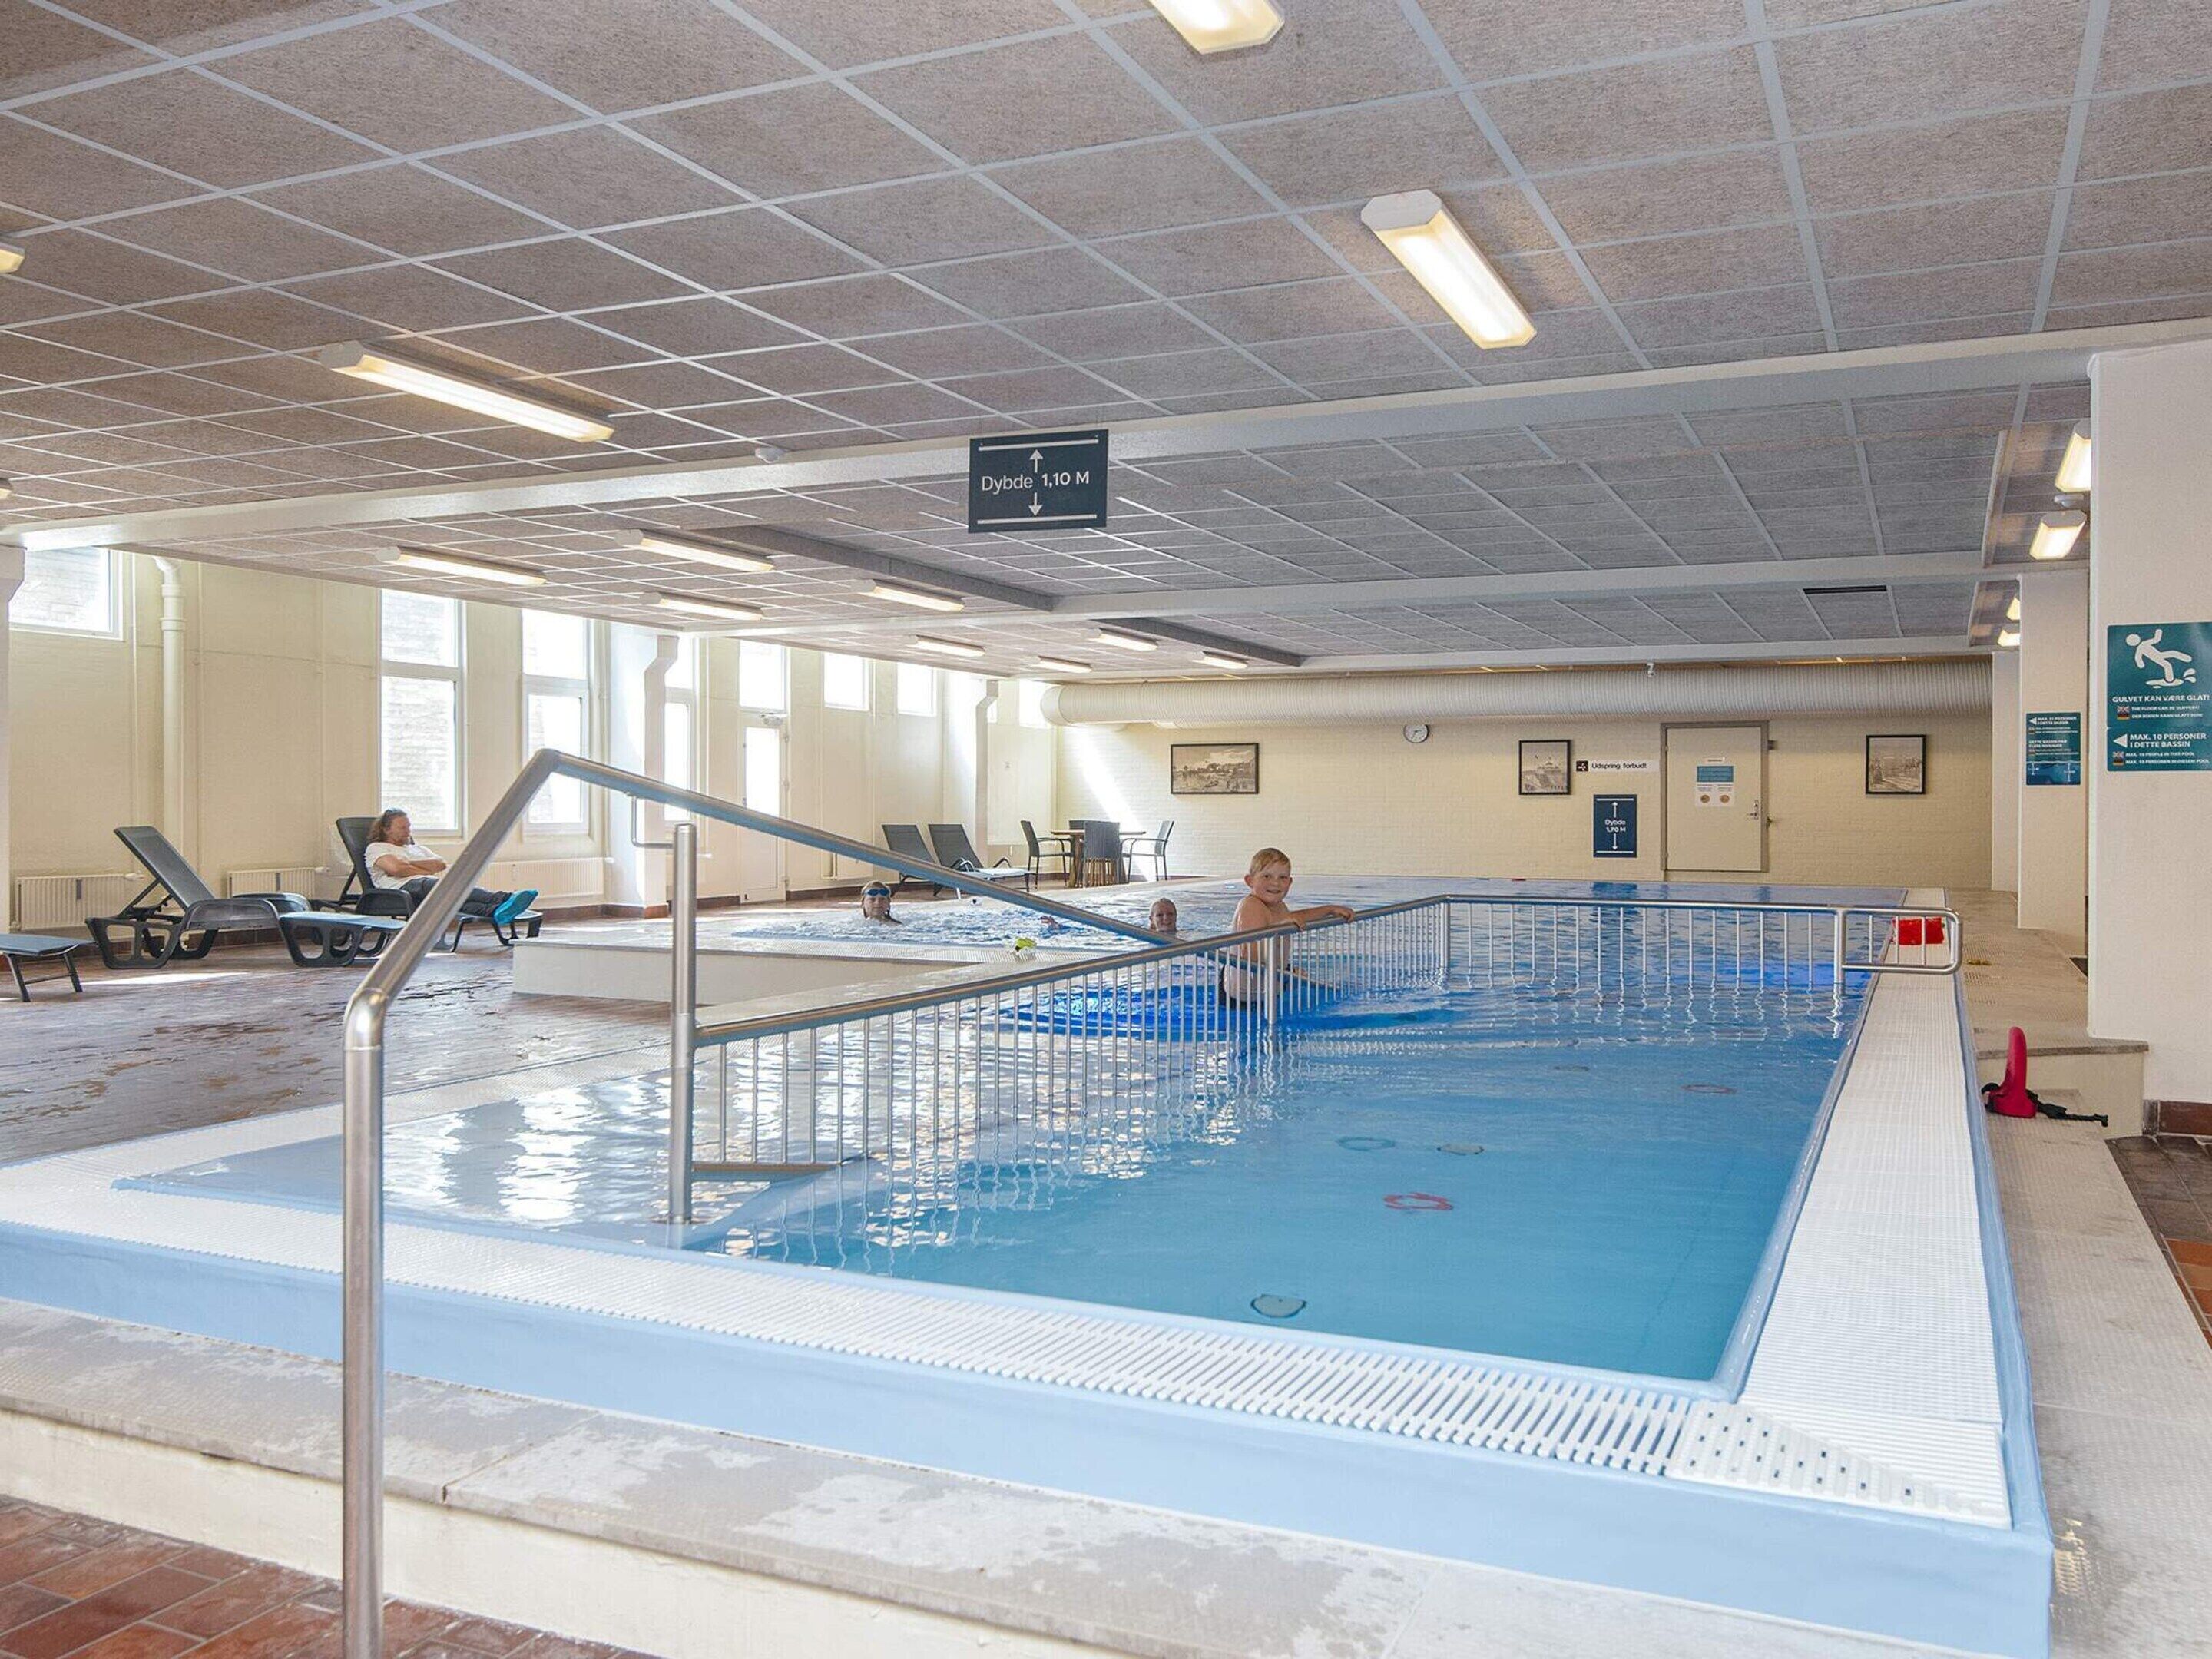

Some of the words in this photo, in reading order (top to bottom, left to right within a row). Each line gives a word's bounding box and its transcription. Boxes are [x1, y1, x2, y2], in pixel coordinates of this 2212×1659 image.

[982, 474, 1033, 495] Dybde
[1041, 472, 1071, 488] 1,10
[1075, 470, 1090, 485] M
[1604, 819, 1626, 827] Dybde
